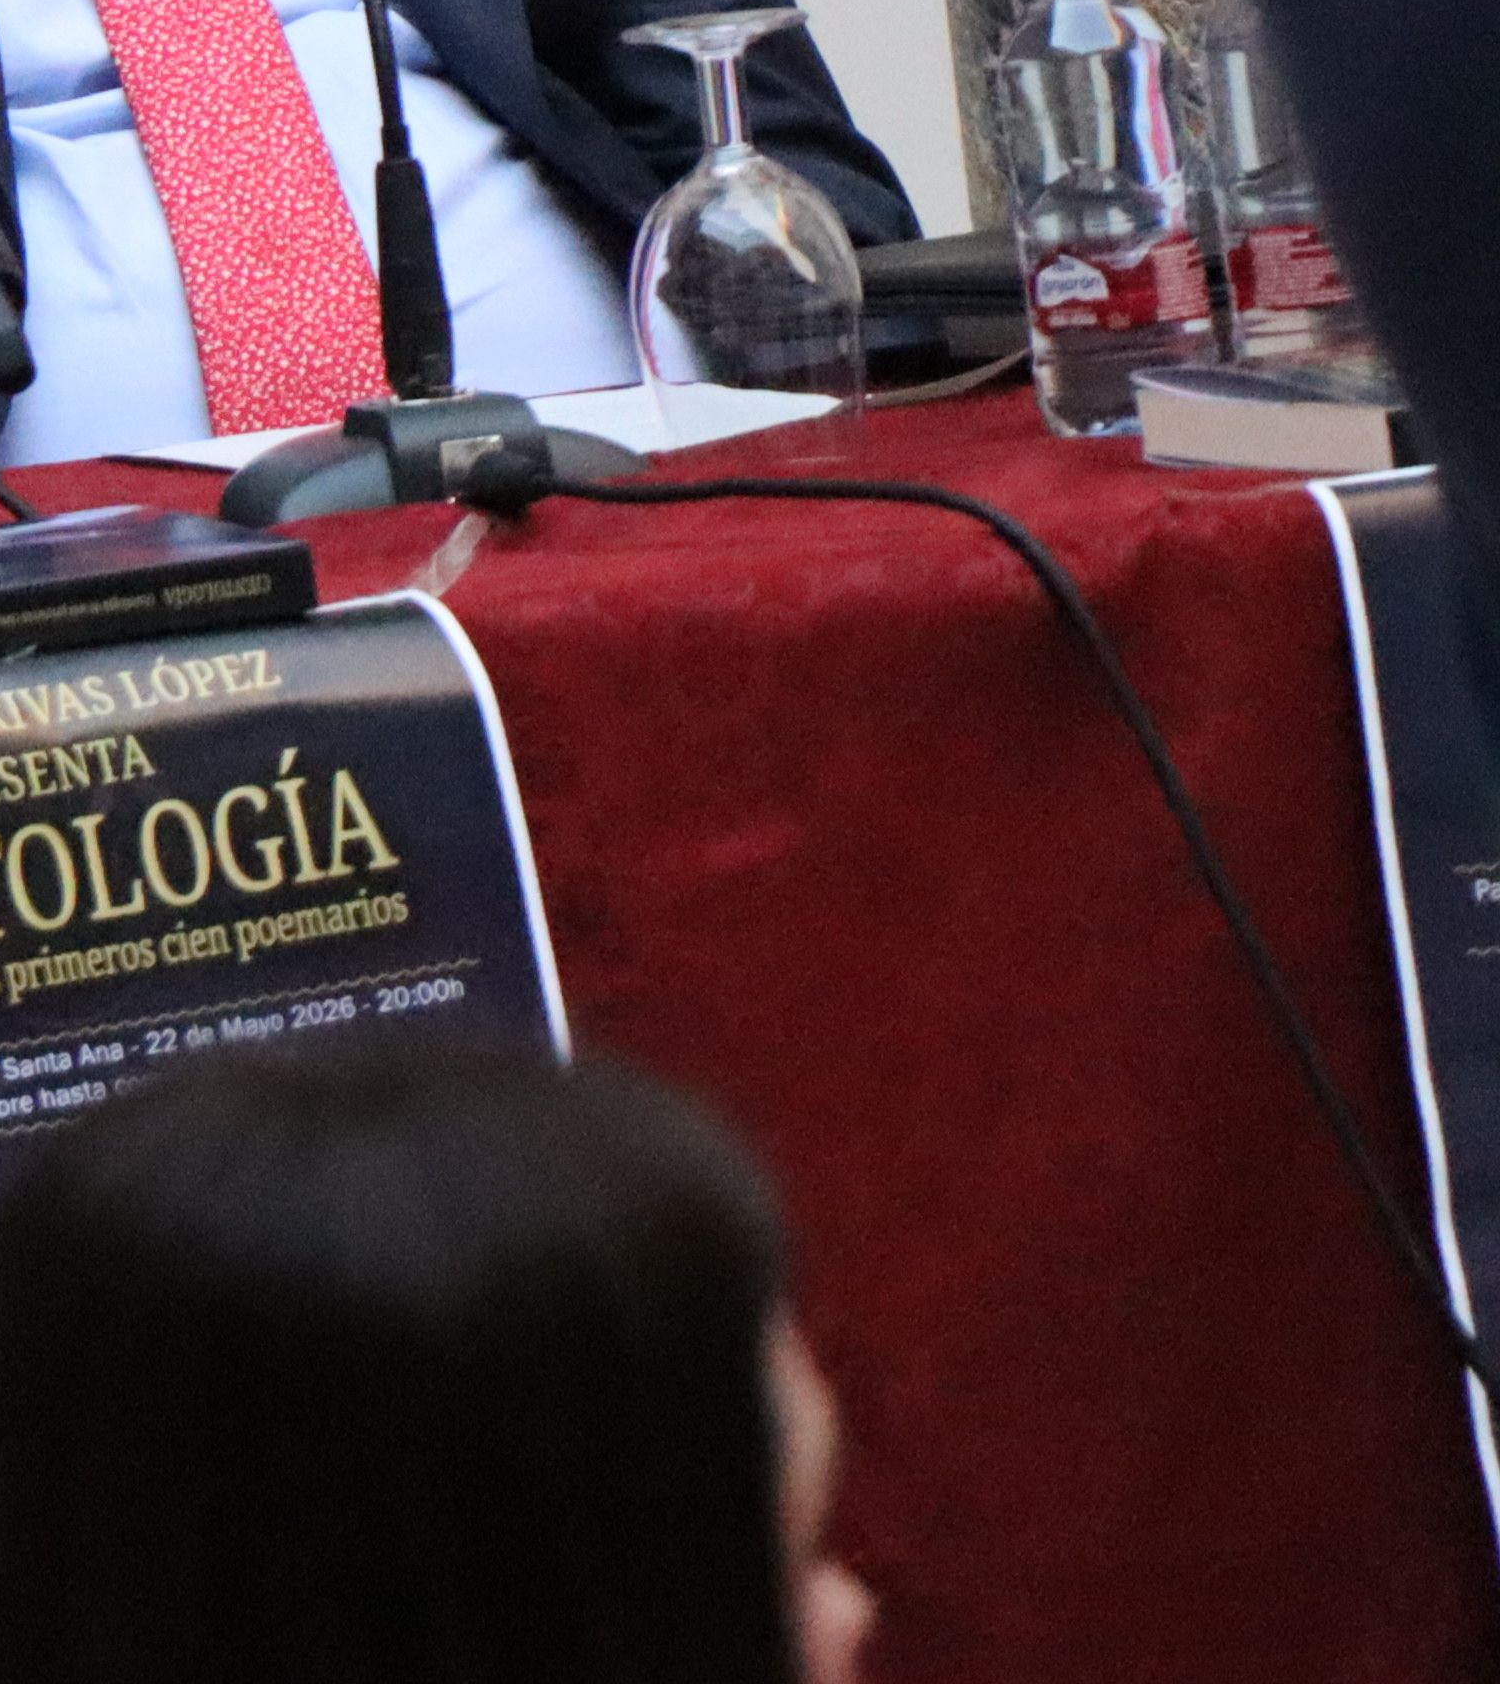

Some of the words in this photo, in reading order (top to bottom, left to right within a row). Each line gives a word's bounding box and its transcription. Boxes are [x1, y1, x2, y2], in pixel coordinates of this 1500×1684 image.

[119, 649, 283, 710] LÓPEZ
[4, 935, 156, 1004] primeros
[161, 922, 231, 965] cien
[236, 888, 409, 963] poemarios
[1, 1050, 73, 1081] Santa
[78, 1039, 124, 1067] Ana
[146, 1029, 179, 1056] 22
[185, 1024, 215, 1048] de
[221, 1013, 284, 1042] Mayo
[291, 995, 356, 1028] 2026
[377, 978, 465, 1013] 20:00h
[38, 1080, 106, 1111] hasta
